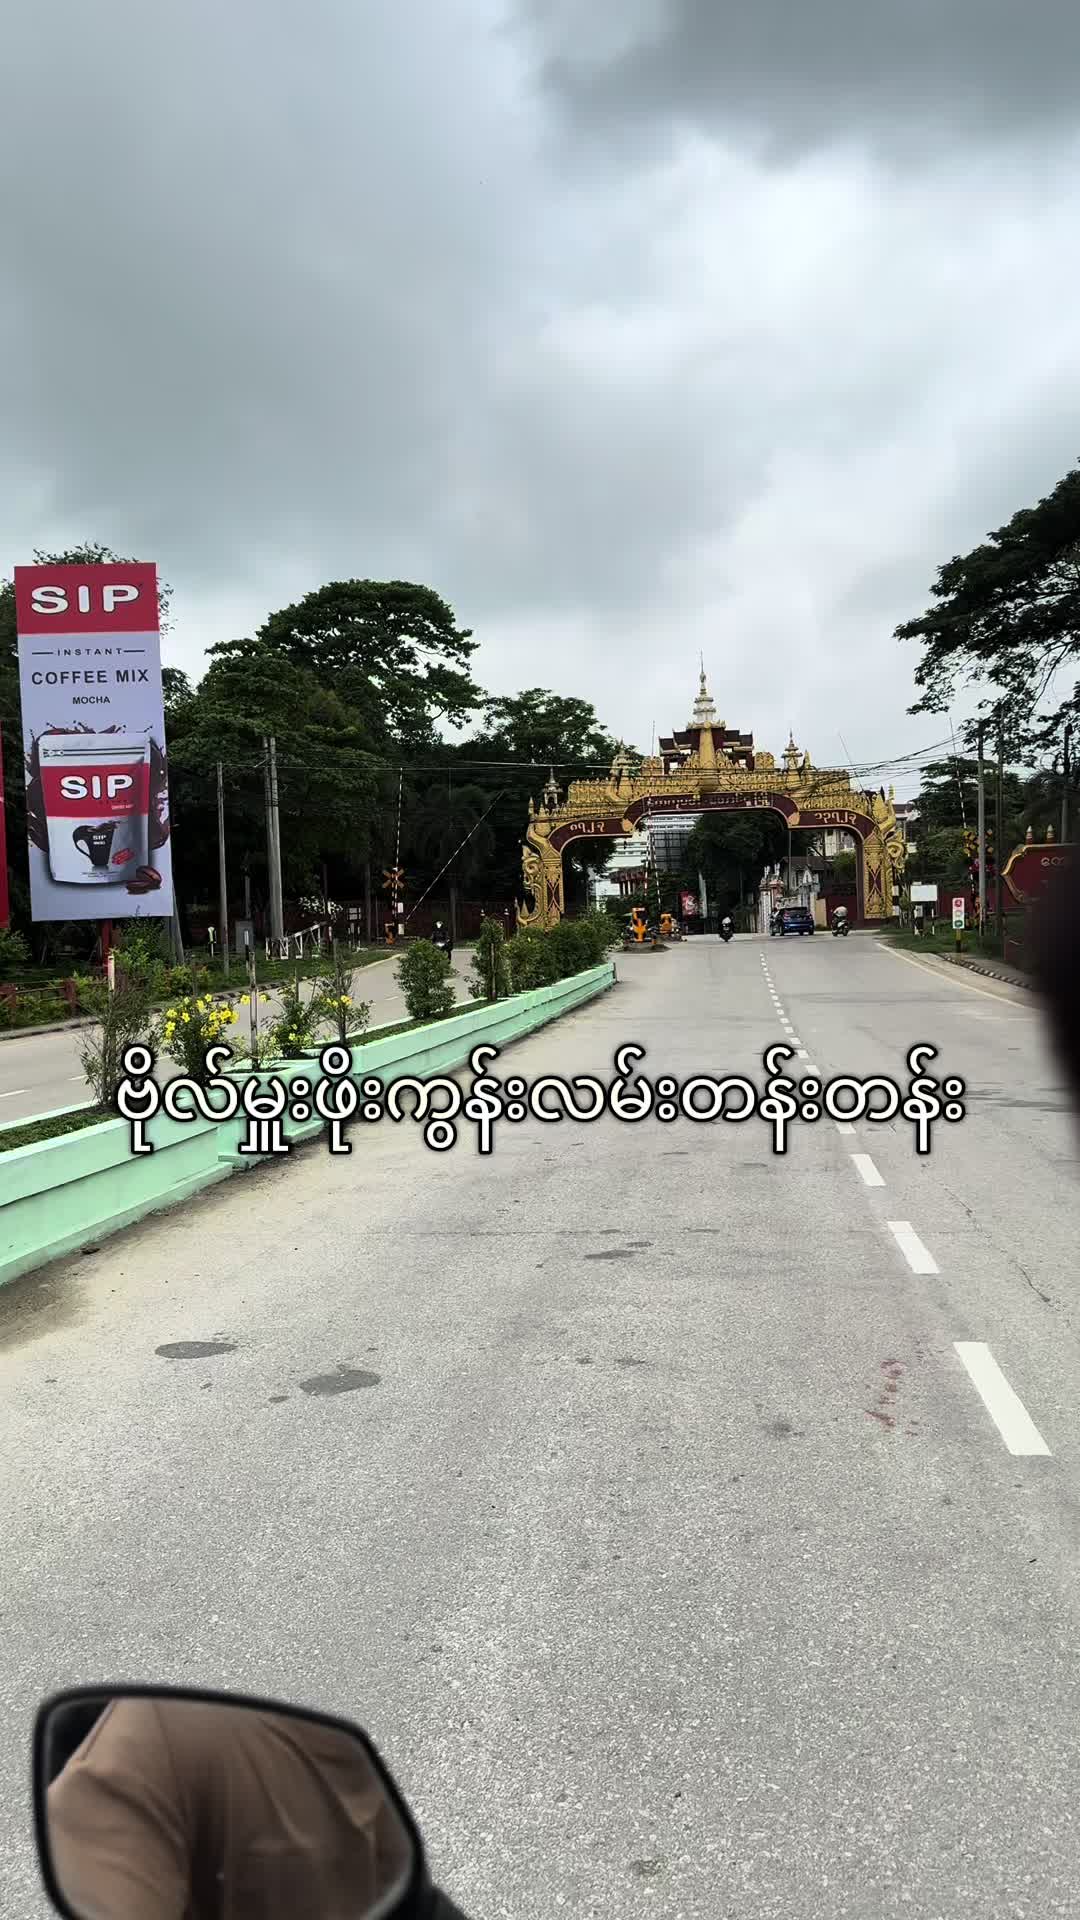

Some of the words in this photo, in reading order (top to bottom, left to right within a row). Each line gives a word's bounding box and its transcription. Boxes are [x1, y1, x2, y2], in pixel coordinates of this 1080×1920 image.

[31, 584, 140, 615] SIP
[57, 648, 122, 656] INSTANT
[31, 670, 108, 685] COFFEE
[116, 669, 149, 683] MIX
[72, 696, 111, 705] MOCHA
[60, 774, 133, 800] SIP
